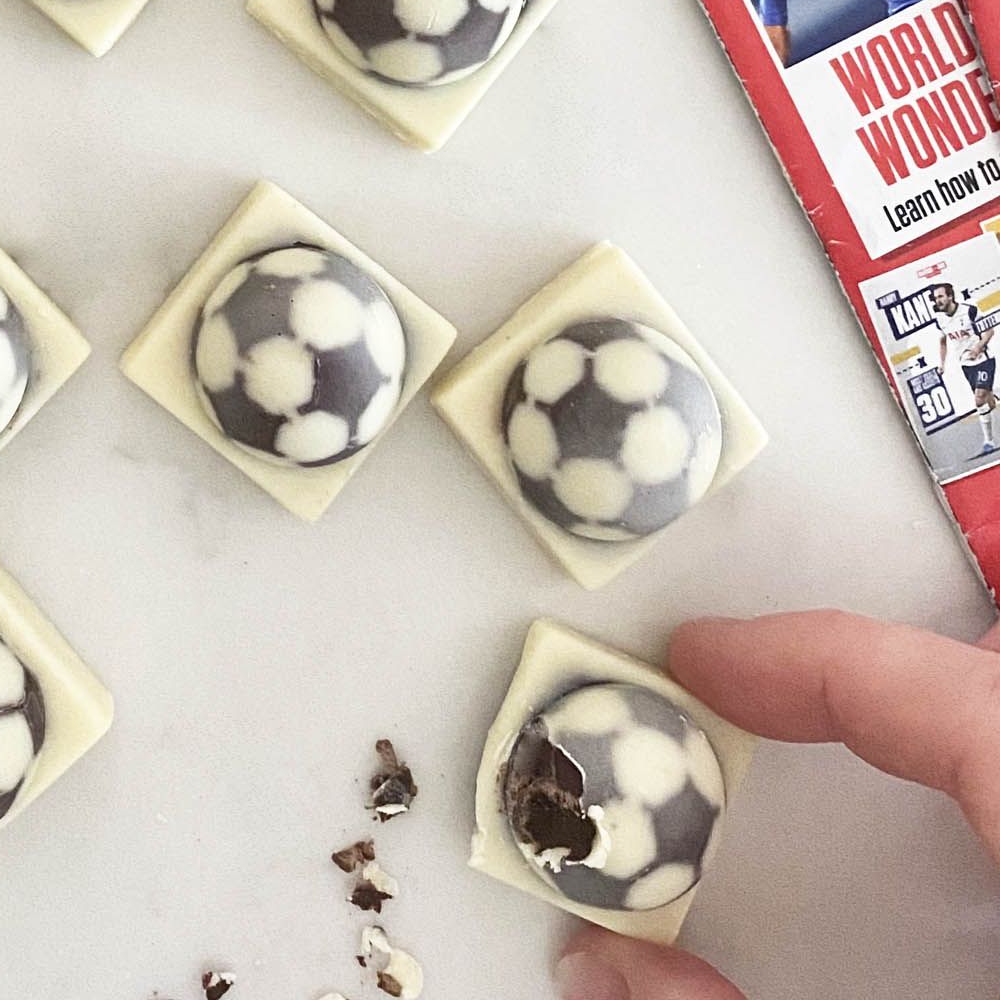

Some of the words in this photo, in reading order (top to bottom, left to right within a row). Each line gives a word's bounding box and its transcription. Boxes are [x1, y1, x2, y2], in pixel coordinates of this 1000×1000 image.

[883, 191, 941, 233] Learn
[934, 168, 980, 206] how
[916, 385, 952, 424] 30
